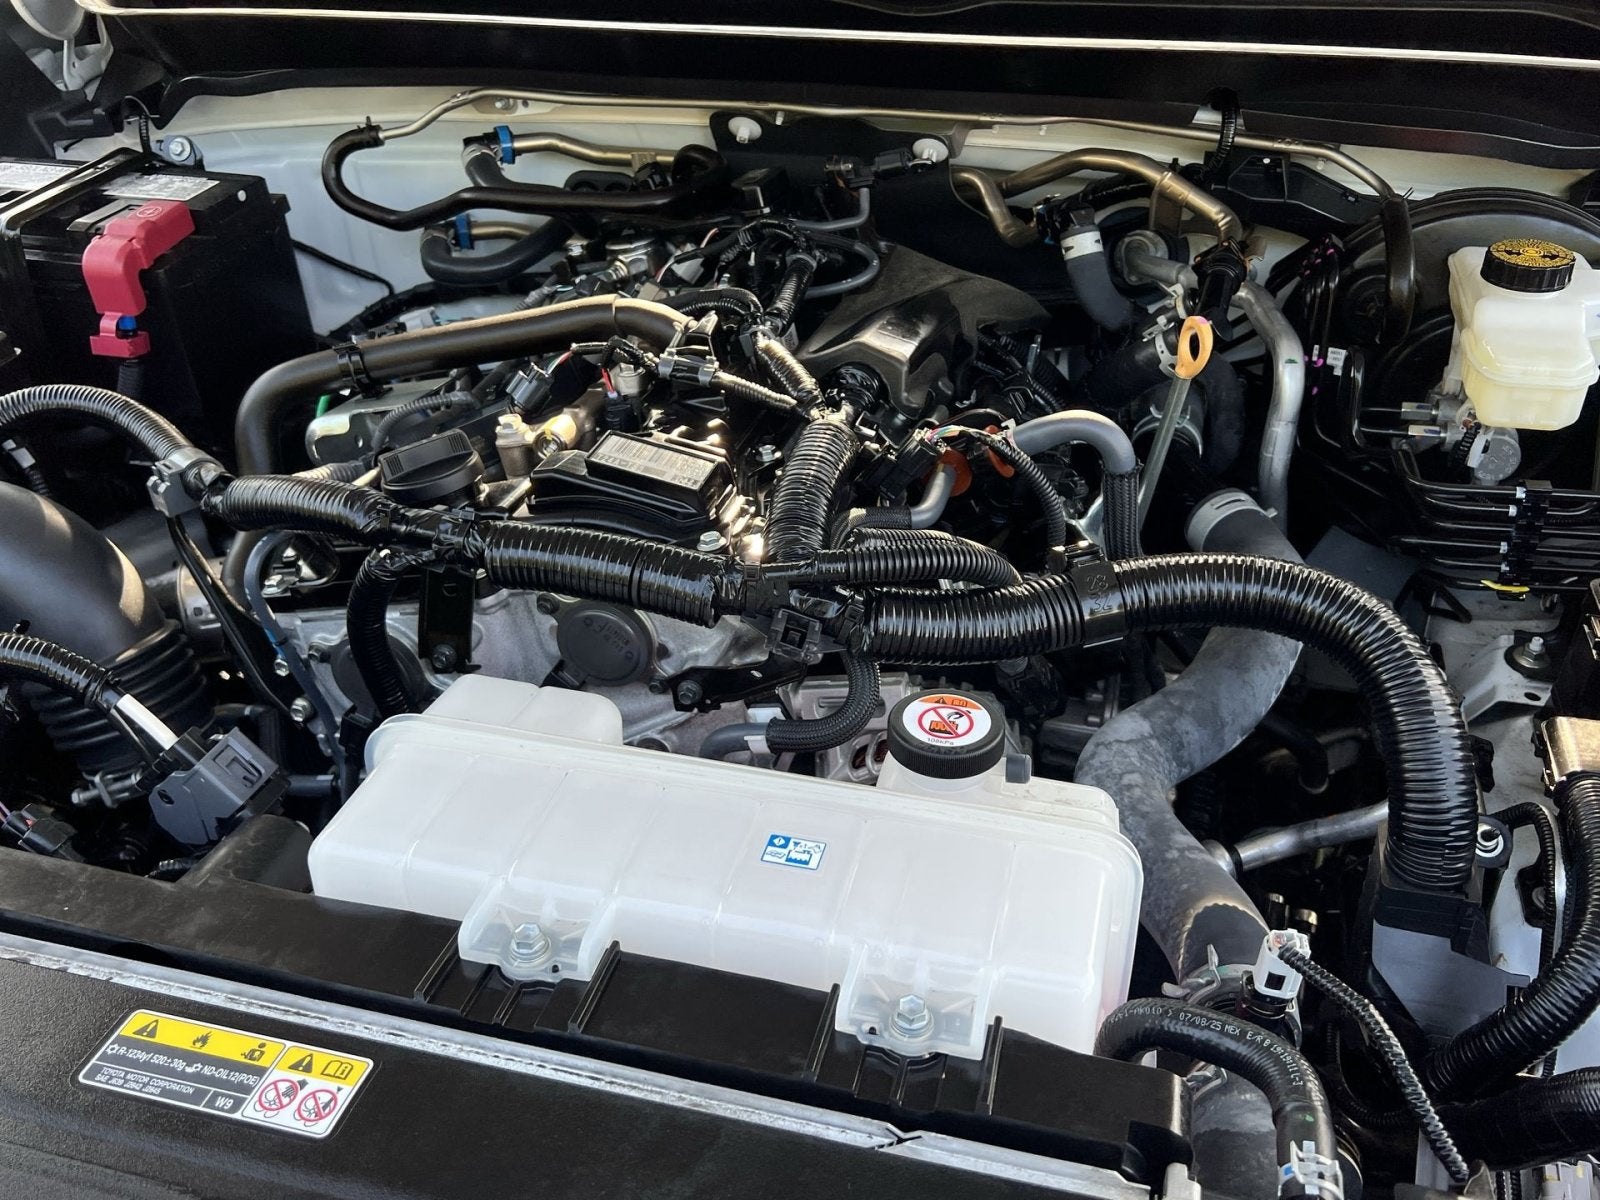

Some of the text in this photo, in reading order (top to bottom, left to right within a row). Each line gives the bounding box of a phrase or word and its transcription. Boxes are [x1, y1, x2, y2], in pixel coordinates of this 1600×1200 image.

[1178, 1012, 1223, 1031] 07/08/25
[1224, 1024, 1241, 1037] MEX
[95, 1073, 110, 1083] SAE
[117, 1046, 154, 1063] R-1234yf
[201, 1064, 261, 1088] ND-OIL12(POE)
[100, 1066, 195, 1095] TOYOTA MOTOR CORPORATION
[215, 1095, 234, 1110] W9
